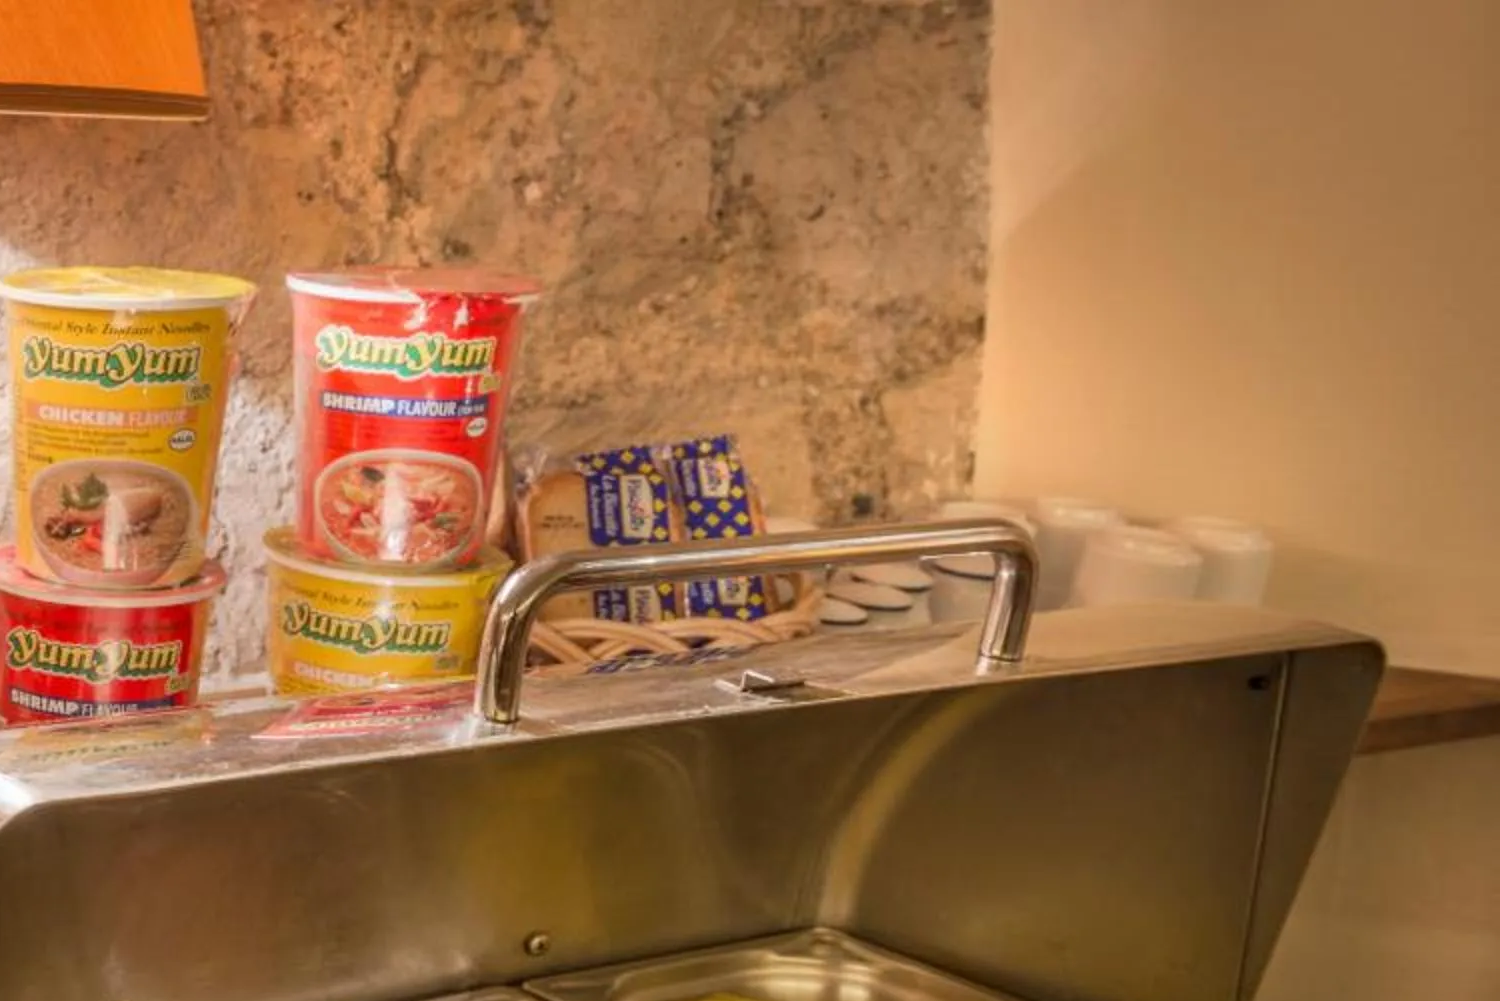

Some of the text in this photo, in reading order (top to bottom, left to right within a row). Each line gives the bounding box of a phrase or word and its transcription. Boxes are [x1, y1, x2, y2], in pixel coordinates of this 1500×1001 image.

[38, 405, 124, 426] CHICKEN
[323, 392, 395, 414] SHRIMP
[397, 400, 457, 417] FLAVOUR
[11, 688, 79, 717] SHRIMP
